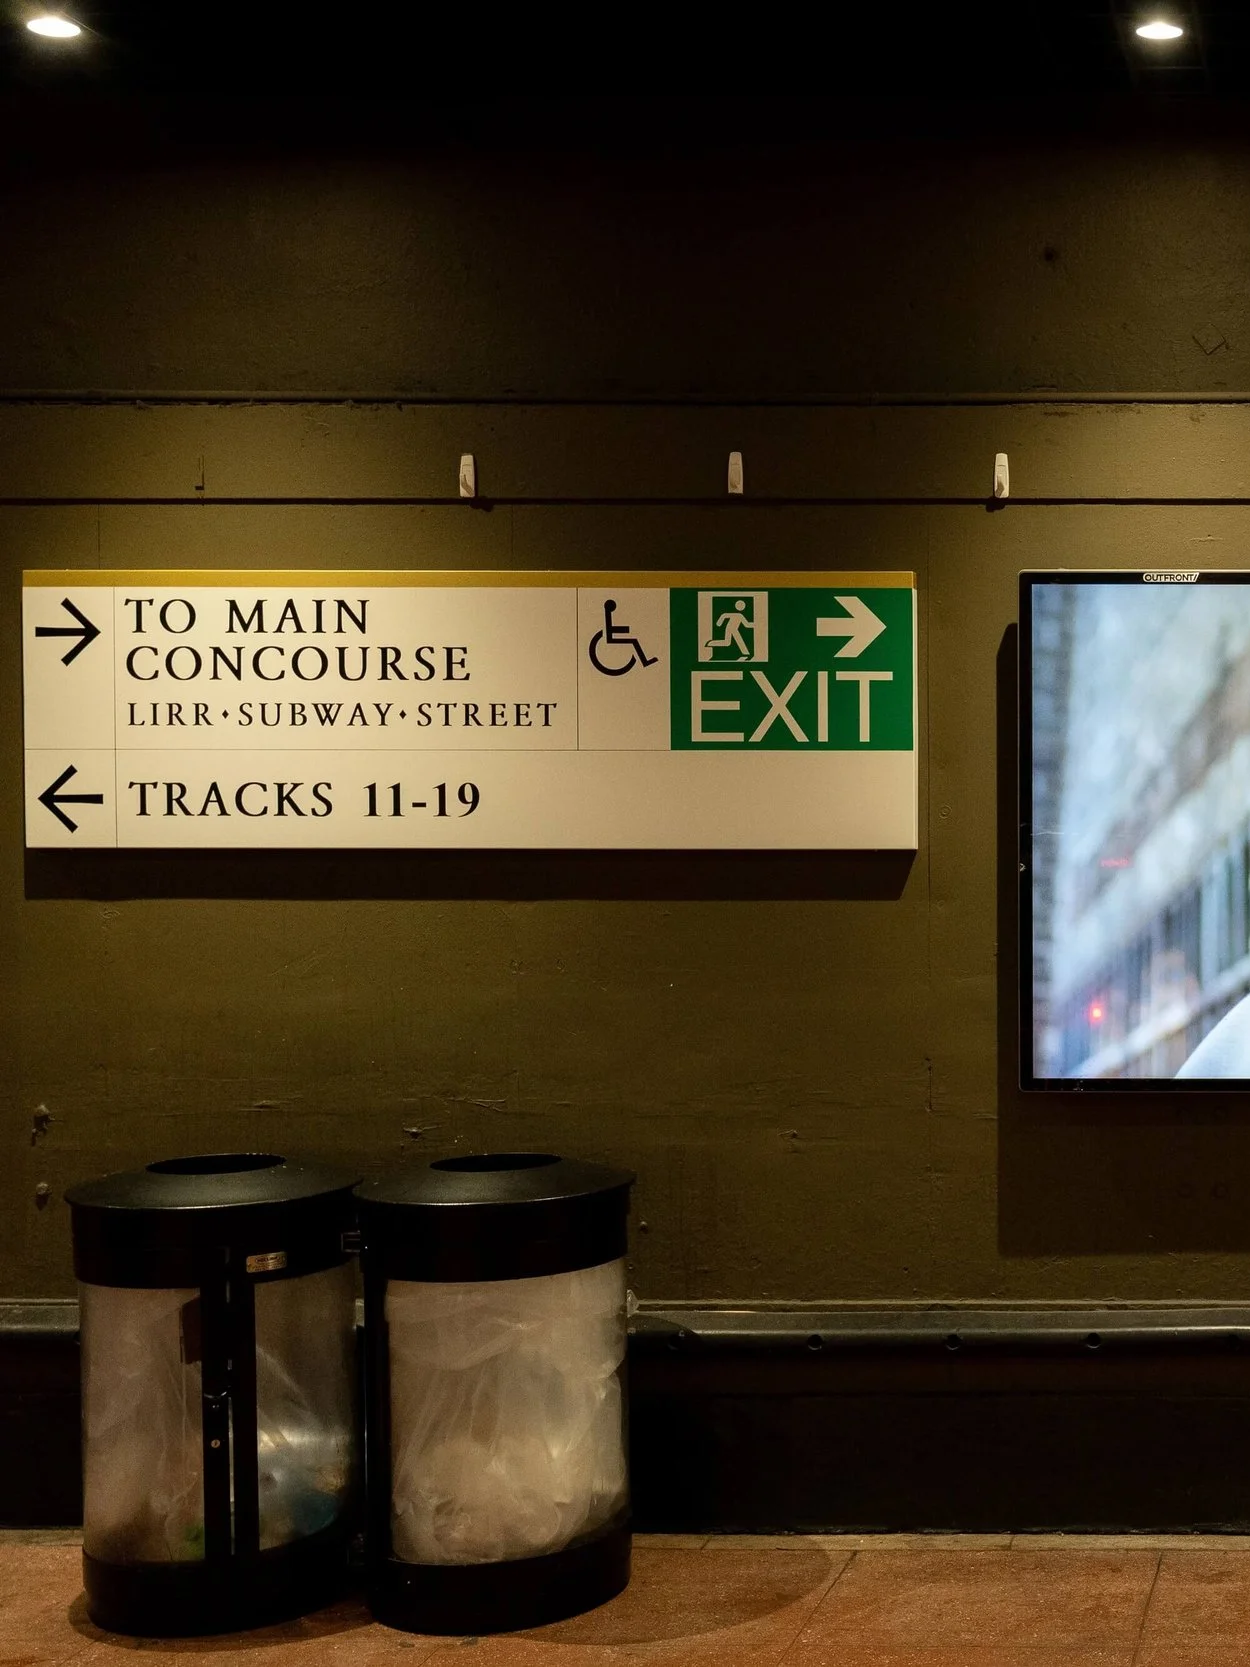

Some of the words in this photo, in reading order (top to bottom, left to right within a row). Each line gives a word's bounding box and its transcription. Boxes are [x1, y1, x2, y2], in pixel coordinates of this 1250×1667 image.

[125, 598, 197, 634] TO
[226, 598, 370, 635] MAIN
[126, 645, 471, 682] CONCOURSE
[127, 702, 213, 727] LIRR
[238, 702, 396, 727] SUBWAY
[416, 702, 558, 727] STREET
[691, 671, 894, 743] EXIT
[128, 781, 333, 818] TRACKS
[363, 782, 480, 818] 11-19
